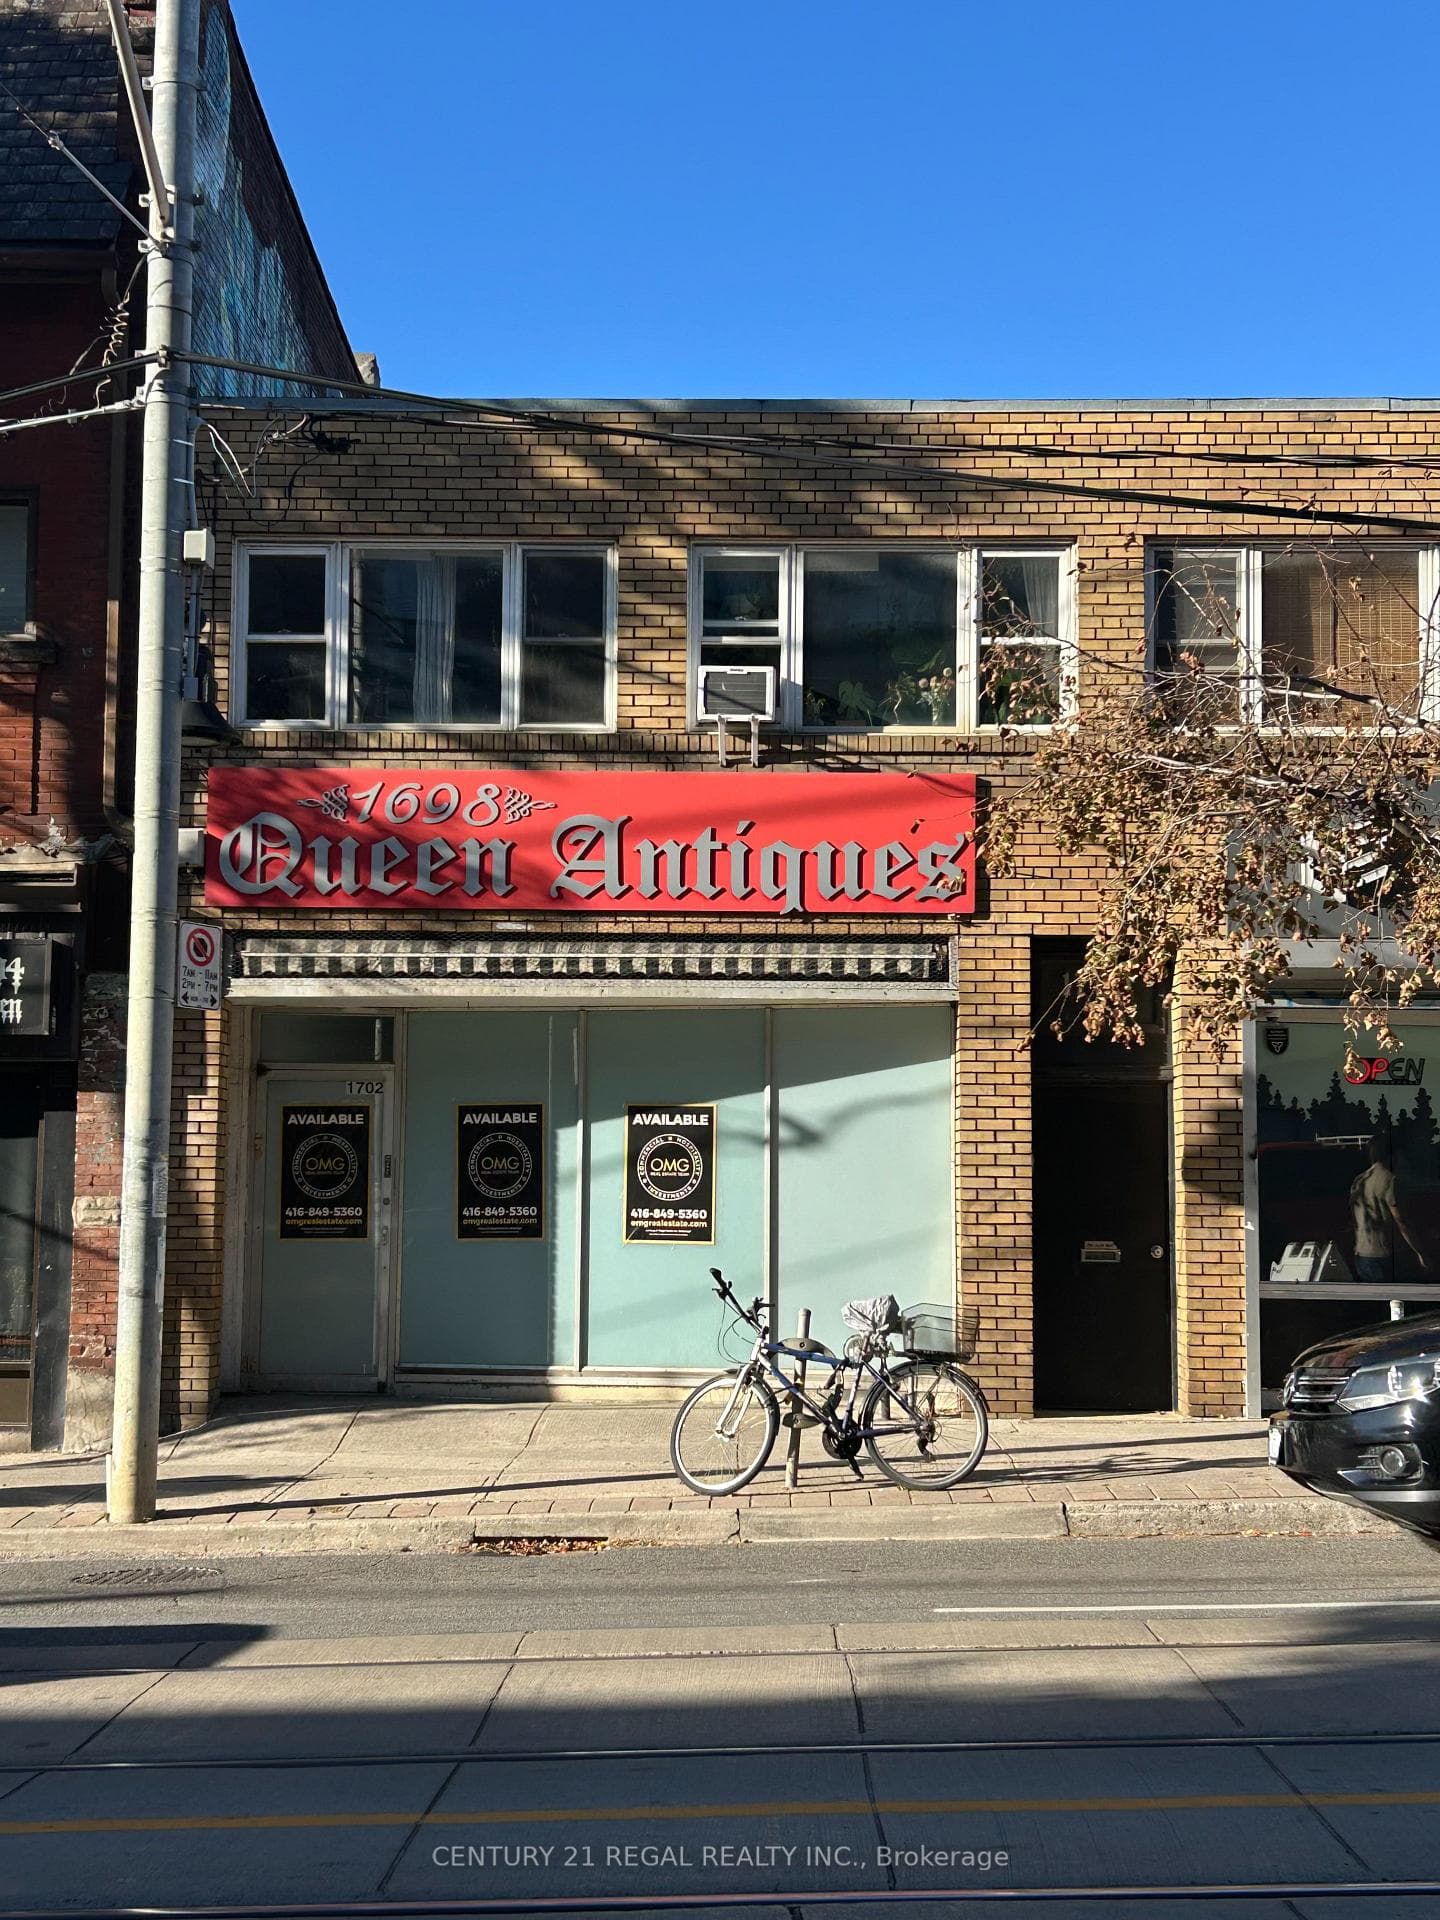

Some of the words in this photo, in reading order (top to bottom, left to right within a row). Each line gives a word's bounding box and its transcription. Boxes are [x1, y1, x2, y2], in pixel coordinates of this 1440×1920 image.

[352, 781, 502, 827] 1698
[218, 811, 517, 898] Queen
[549, 813, 967, 915] Antiques
[182, 977, 195, 990] 2PM
[204, 981, 218, 992] 7PM
[1344, 1057, 1426, 1085] OPEN
[347, 1082, 384, 1094] 1702
[287, 1113, 364, 1125] AVAILABLE
[463, 1112, 538, 1124] AVAILABLE
[632, 1113, 709, 1126] AVAILABLE
[305, 1157, 345, 1171] OMG
[481, 1156, 520, 1170] OMG
[650, 1158, 690, 1172] OMG
[285, 1207, 363, 1217] 416-849-5360
[462, 1206, 537, 1216] 416-849-5360
[630, 1208, 708, 1220] 416-849-5360
[285, 1217, 363, 1226] omgrealestate.com
[462, 1217, 538, 1226] omgrealestate.com
[630, 1219, 708, 1228] omgrealestate.com
